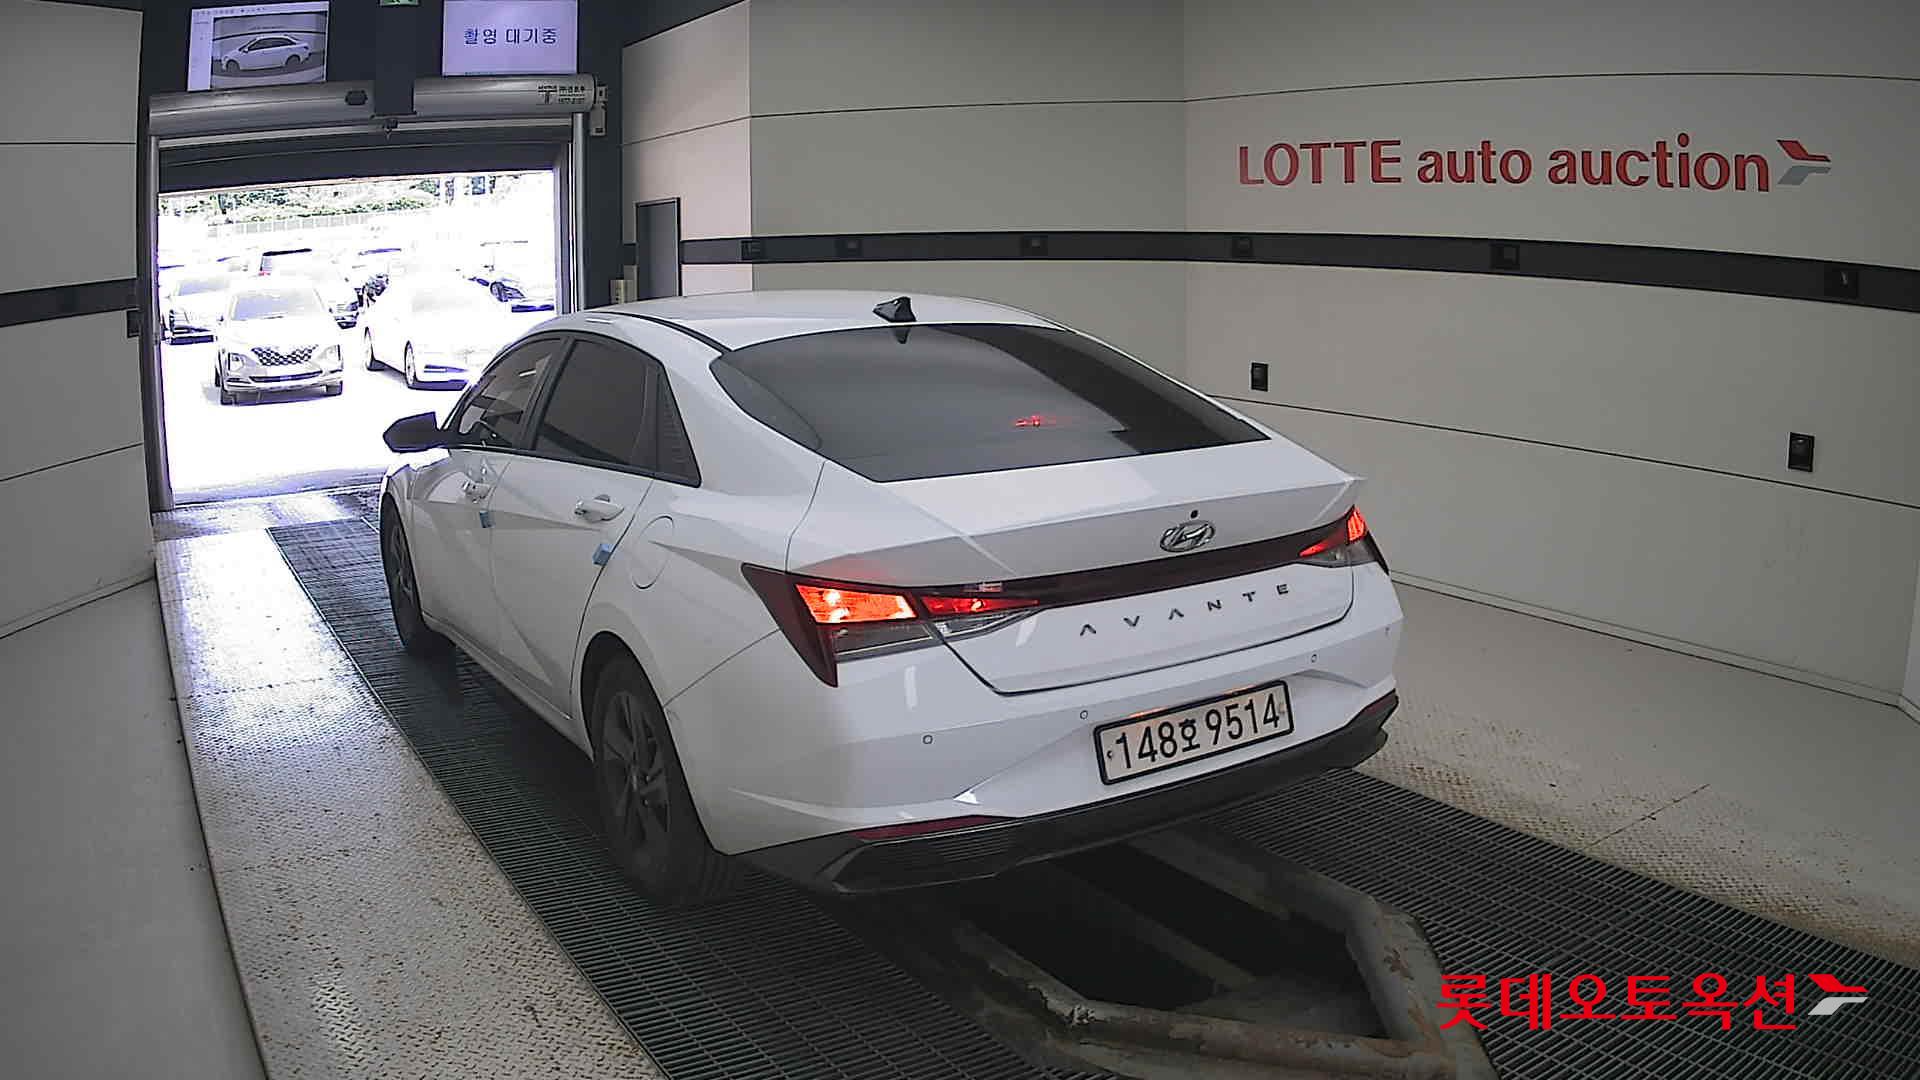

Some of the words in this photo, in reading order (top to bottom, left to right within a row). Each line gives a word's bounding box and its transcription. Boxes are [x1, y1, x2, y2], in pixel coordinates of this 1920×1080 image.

[505, 28, 557, 45] 대기중
[1238, 140, 1402, 186] LOTTE
[1417, 140, 1533, 185] auto
[1548, 132, 1770, 193] auction
[1079, 583, 1290, 637] AVANTE
